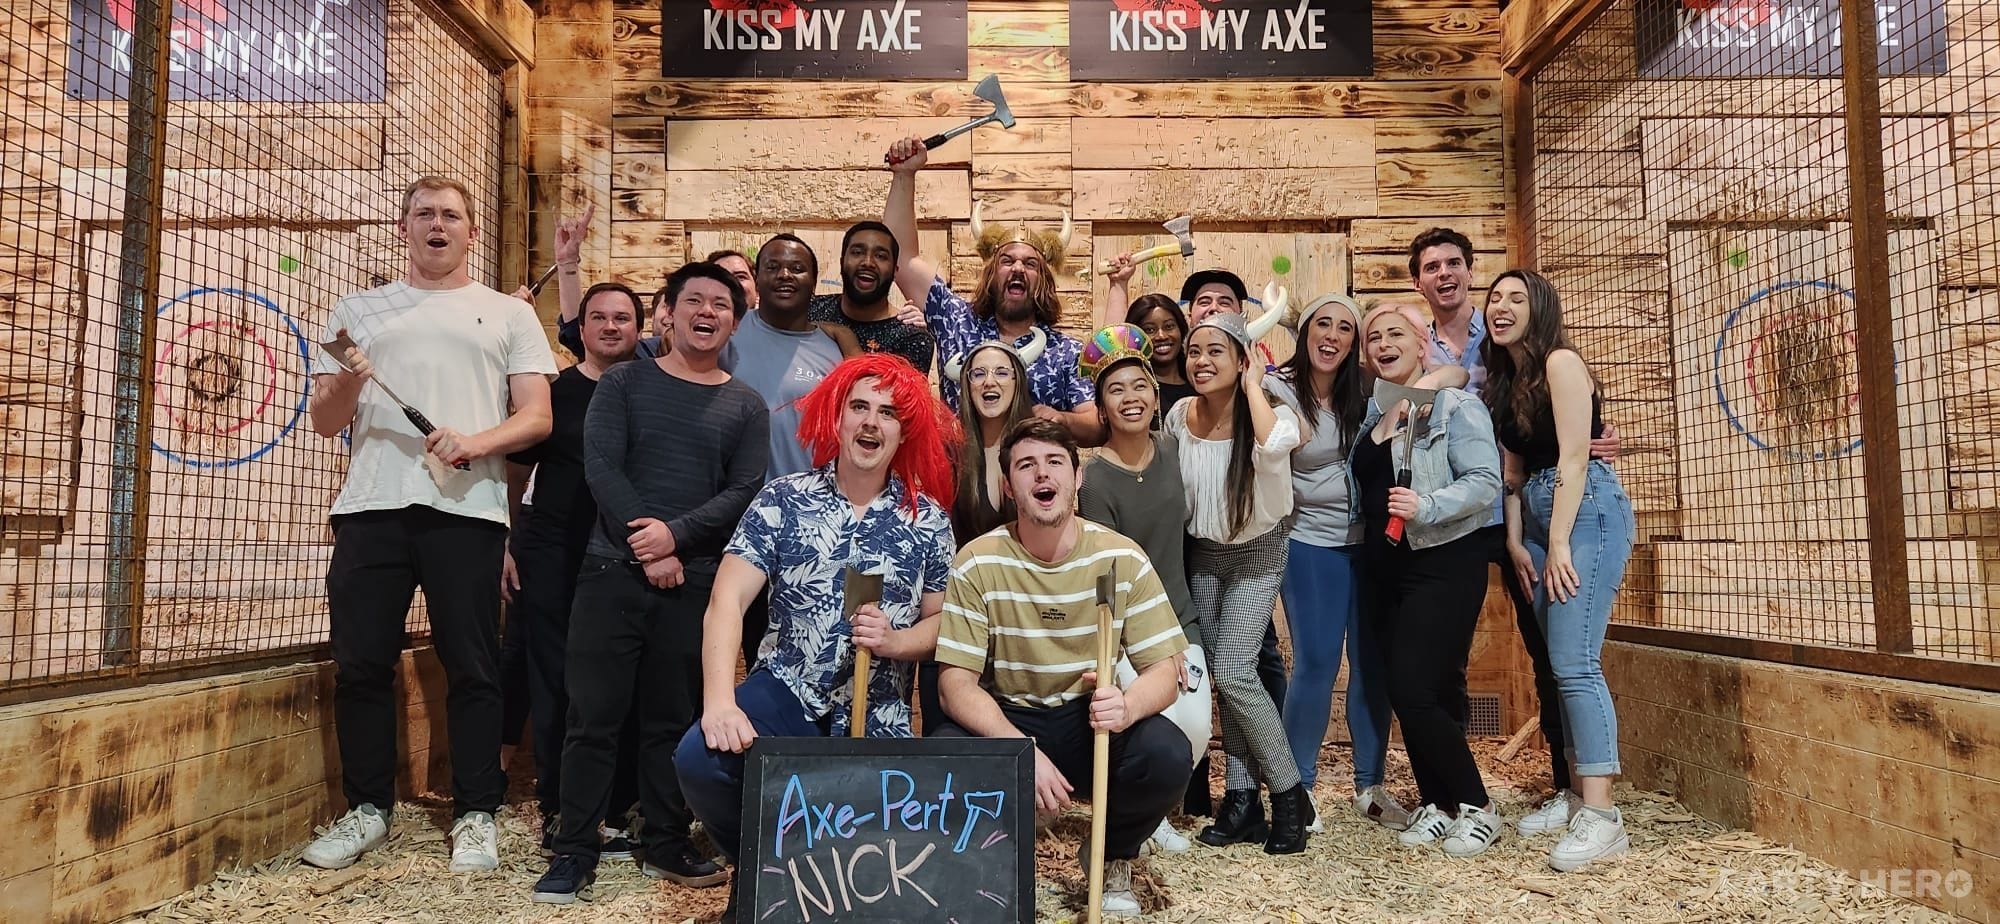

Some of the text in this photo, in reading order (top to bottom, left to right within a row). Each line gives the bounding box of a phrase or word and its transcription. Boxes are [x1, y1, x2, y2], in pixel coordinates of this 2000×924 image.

[204, 30, 257, 73] MY
[269, 14, 338, 76] AXE
[703, 0, 923, 52] KISS MY AXE
[1109, 0, 1327, 52] KISS MY AXE
[1676, 6, 1758, 48] KISS
[1769, 6, 1821, 48] MY
[775, 769, 955, 859] Axe-Pert
[787, 838, 939, 923] NICK
